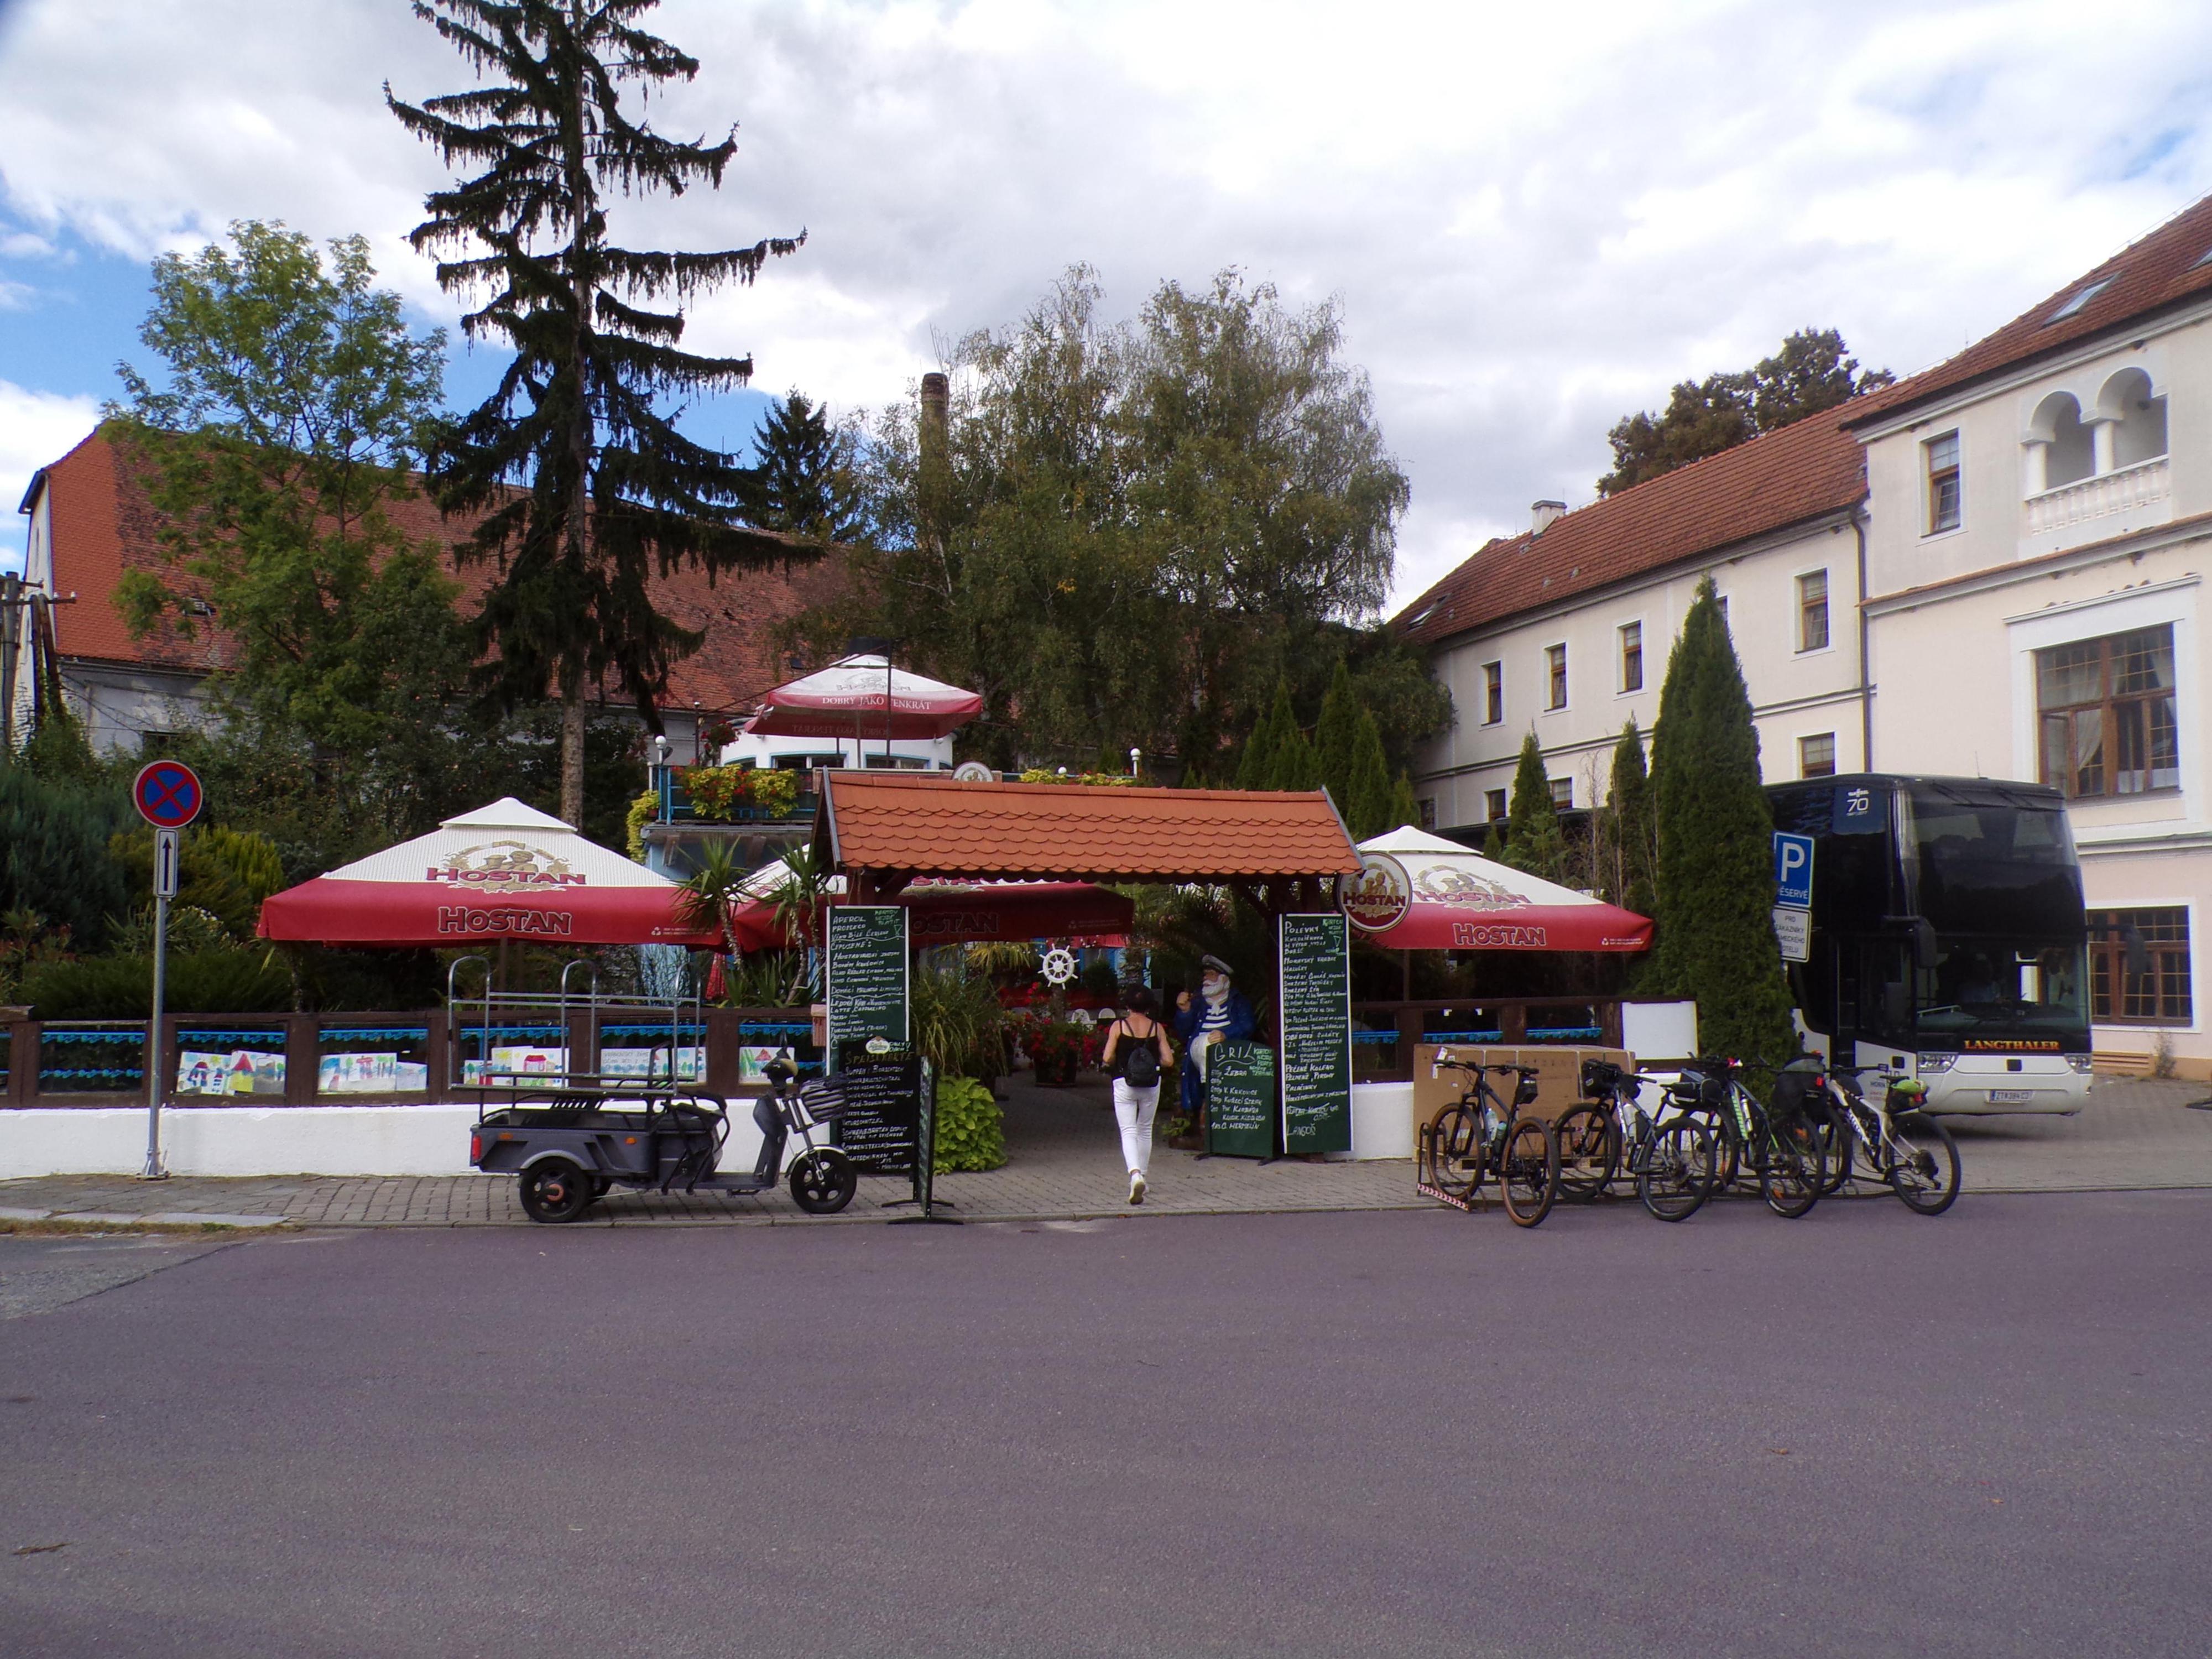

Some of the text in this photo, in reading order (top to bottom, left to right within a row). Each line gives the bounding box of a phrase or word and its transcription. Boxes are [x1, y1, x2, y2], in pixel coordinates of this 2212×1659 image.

[857, 696, 884, 706] JAKO
[1846, 797, 1869, 812] 70
[1781, 842, 1805, 883] P
[426, 867, 586, 885] HOSTAN
[1342, 891, 1406, 907] HOSTAN
[1413, 890, 1532, 904] HOSTAN
[1778, 886, 1808, 899] ÉSERVÉ
[439, 906, 572, 936] HOSTAN
[833, 916, 866, 924] APEROL
[909, 911, 1001, 935] OSTAN
[1285, 921, 1319, 935] POLÉVKY
[1453, 923, 1546, 946] HOSTAN
[1780, 935, 1805, 944] MECKÉHO
[1964, 1040, 2060, 1050] LANGTHALER
[1214, 1043, 1255, 1062] GRIL
[1224, 1065, 1248, 1077] ŽEBRA
[1310, 1063, 1335, 1072] KOLENO
